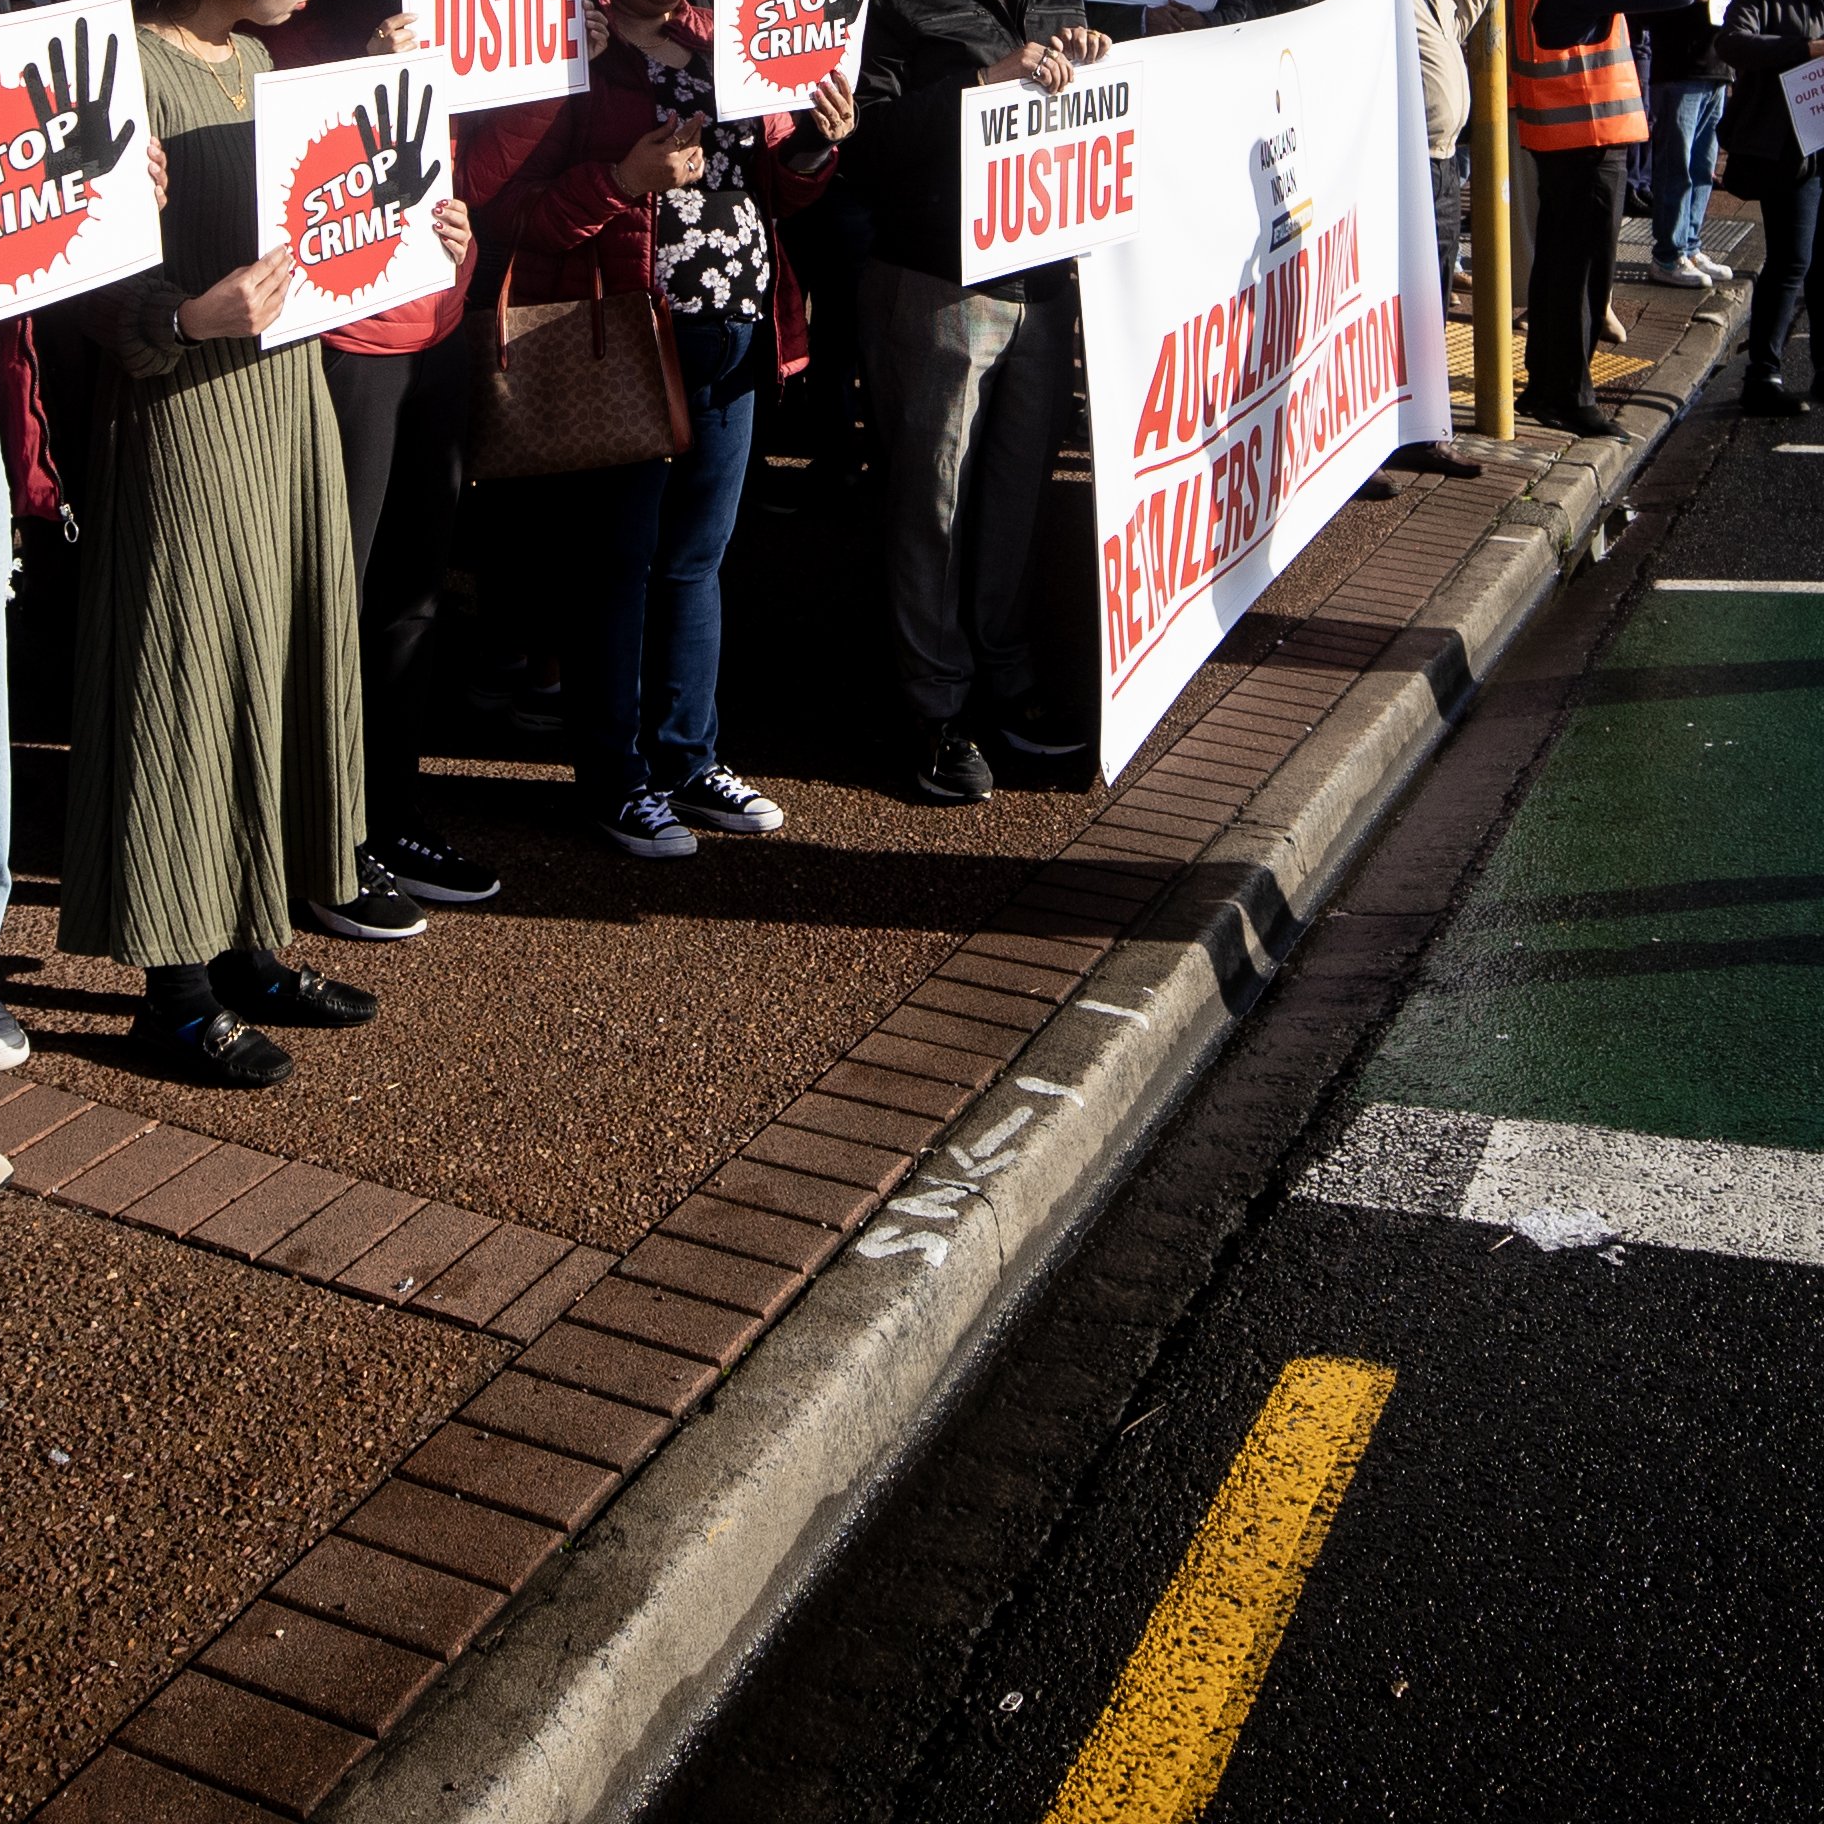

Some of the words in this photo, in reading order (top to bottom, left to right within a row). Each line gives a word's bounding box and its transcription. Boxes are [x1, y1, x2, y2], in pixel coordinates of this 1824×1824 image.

[748, 16, 849, 63] CRIME
[980, 99, 1020, 148] WE
[1027, 80, 1130, 138] DEMAND
[1795, 87, 1822, 104] OUR
[302, 148, 400, 227] STOP
[973, 130, 1137, 250] JUSTICE
[299, 206, 404, 269] CRIME
[1133, 248, 1311, 459] AUCKLAND
[1104, 417, 1266, 676] RETAILERS
[1270, 294, 1409, 514] ASSOCIATION
